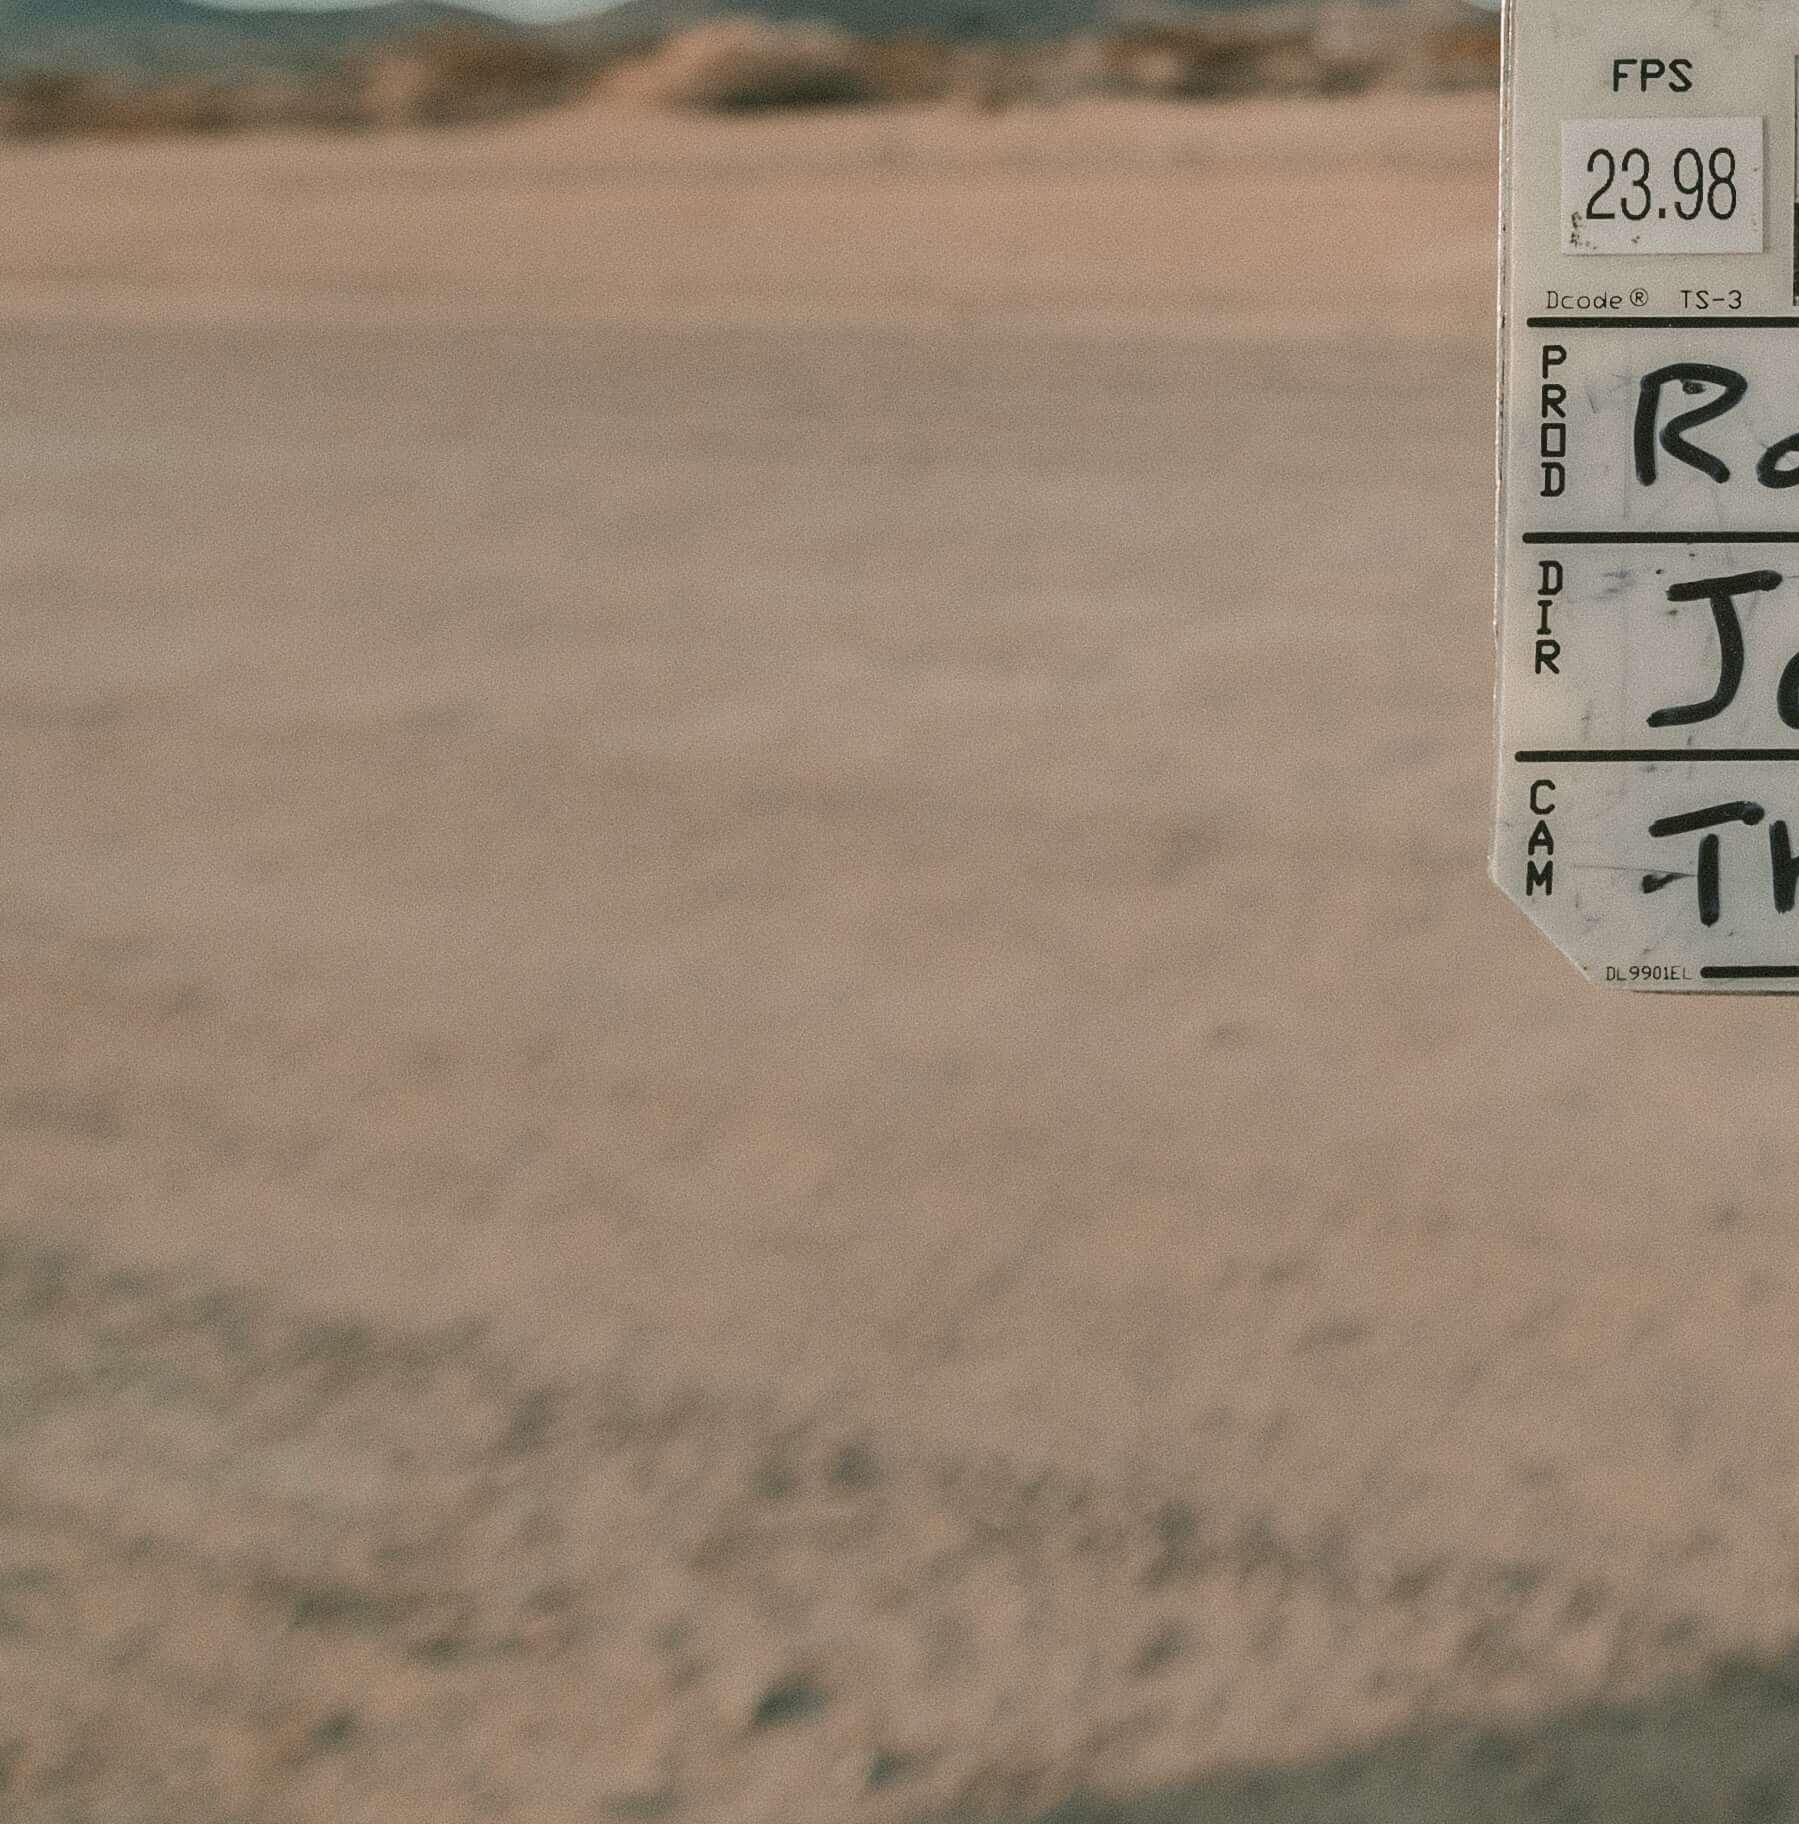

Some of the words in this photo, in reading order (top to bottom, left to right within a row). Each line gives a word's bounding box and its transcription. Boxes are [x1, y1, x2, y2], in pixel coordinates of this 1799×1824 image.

[1612, 58, 1693, 93] FPS
[1586, 147, 1738, 221] 23.98
[1680, 289, 1743, 310] TS-3
[1540, 344, 1567, 498] PROD
[1534, 560, 1564, 675] DIR
[1525, 779, 1556, 897] CAM
